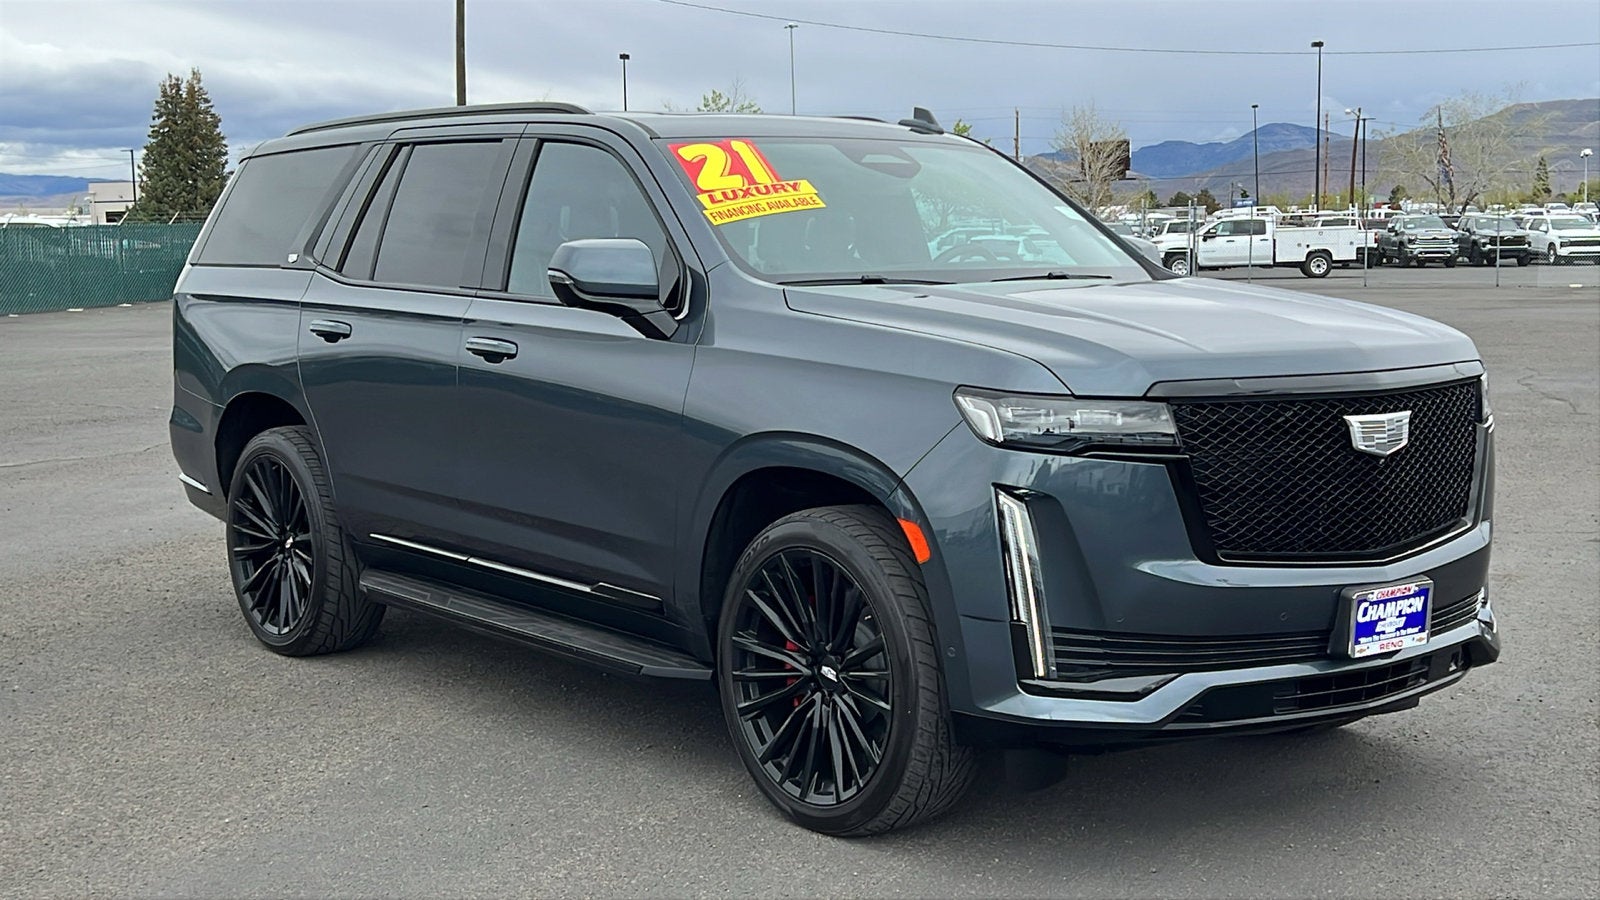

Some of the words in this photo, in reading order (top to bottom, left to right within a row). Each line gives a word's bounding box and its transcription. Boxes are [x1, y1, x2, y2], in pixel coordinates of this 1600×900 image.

[678, 140, 775, 191] 21
[707, 182, 801, 205] LUXURY
[710, 203, 767, 222] FINANCING
[768, 196, 821, 211] AVAILABLE
[1376, 586, 1413, 600] CHAMPION
[1357, 596, 1424, 623] CHAMPION
[1379, 640, 1404, 651] RENO
